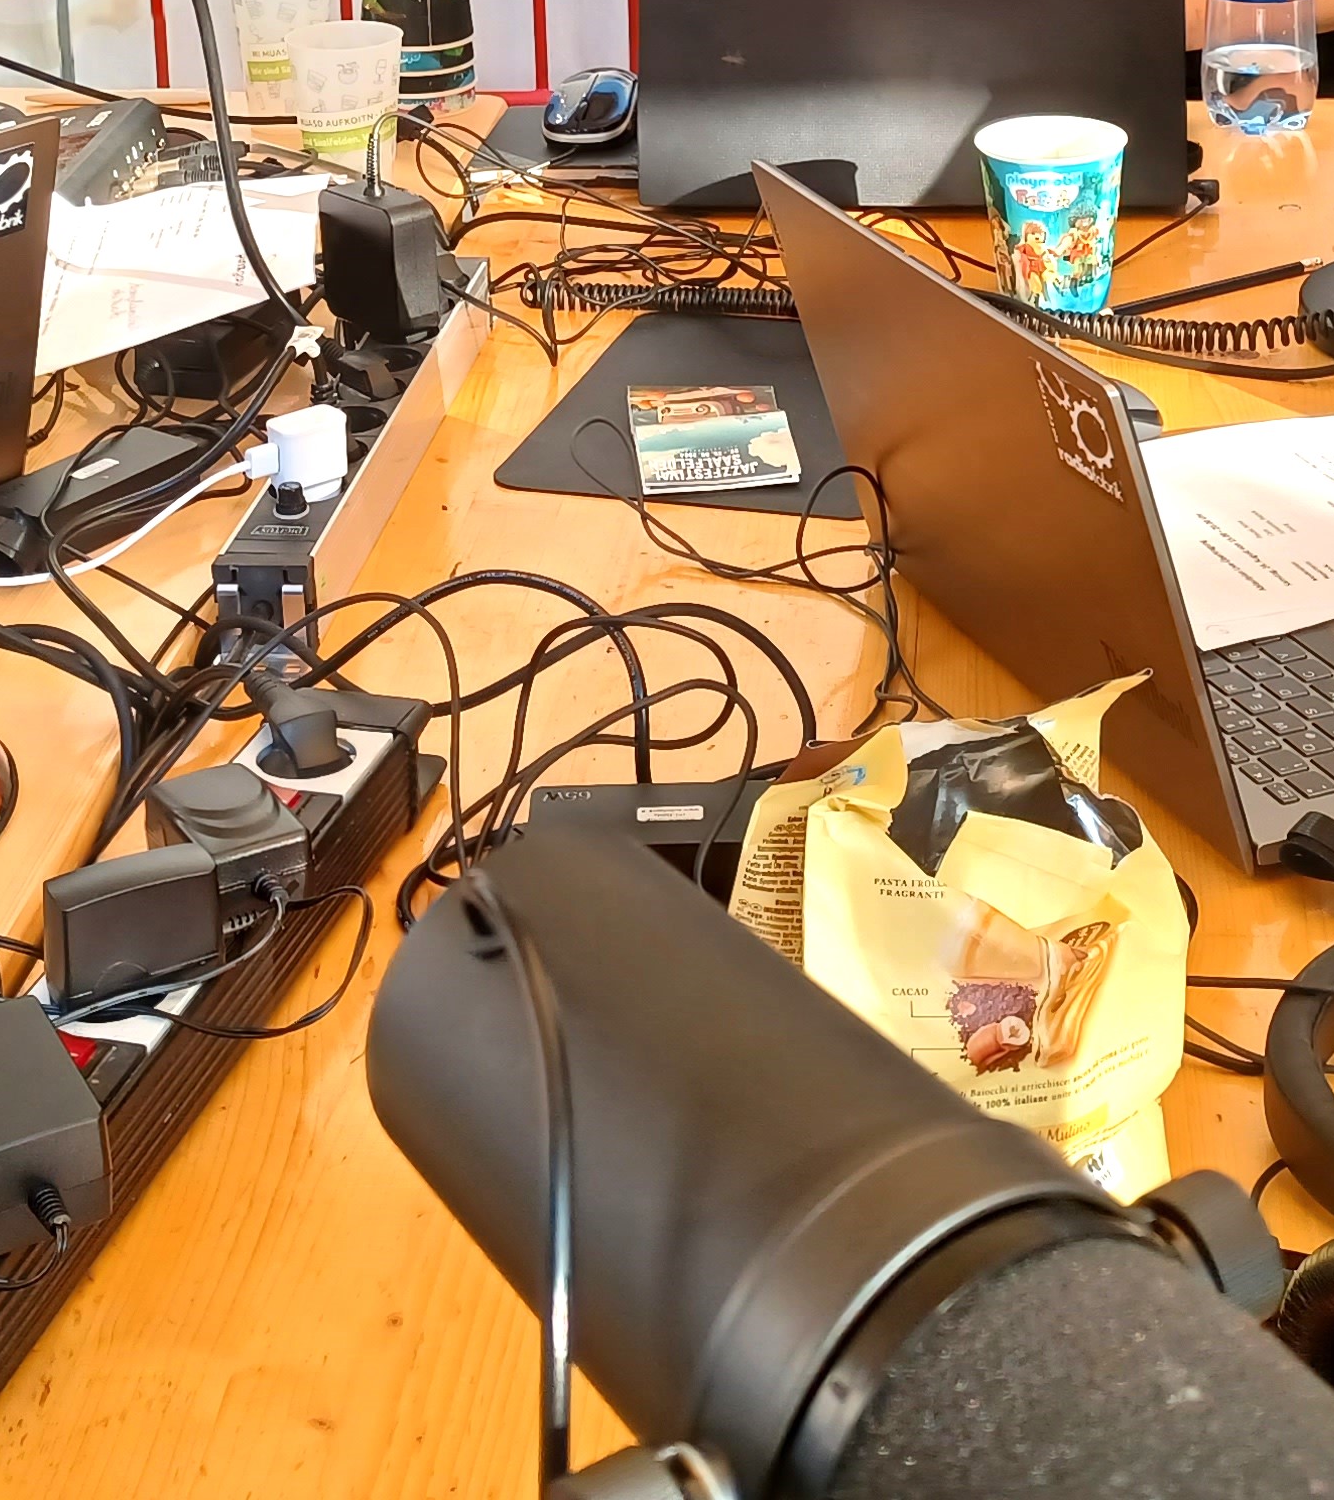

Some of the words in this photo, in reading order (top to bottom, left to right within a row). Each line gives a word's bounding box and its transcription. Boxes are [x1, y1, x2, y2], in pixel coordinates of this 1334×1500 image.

[262, 49, 287, 58] MUAS
[649, 453, 743, 471] SAALFELDEN
[655, 460, 759, 481] JAZZFESTIVAL
[542, 789, 592, 803] 65W
[874, 877, 908, 887] PASTA
[879, 888, 947, 900] FRAGRANTE
[891, 987, 929, 997] CACAO
[970, 1085, 1008, 1098] Baiocchi
[986, 1098, 1011, 1110] 100%
[1014, 1094, 1048, 1107] italiane
[1046, 1120, 1091, 1144] Mulino
